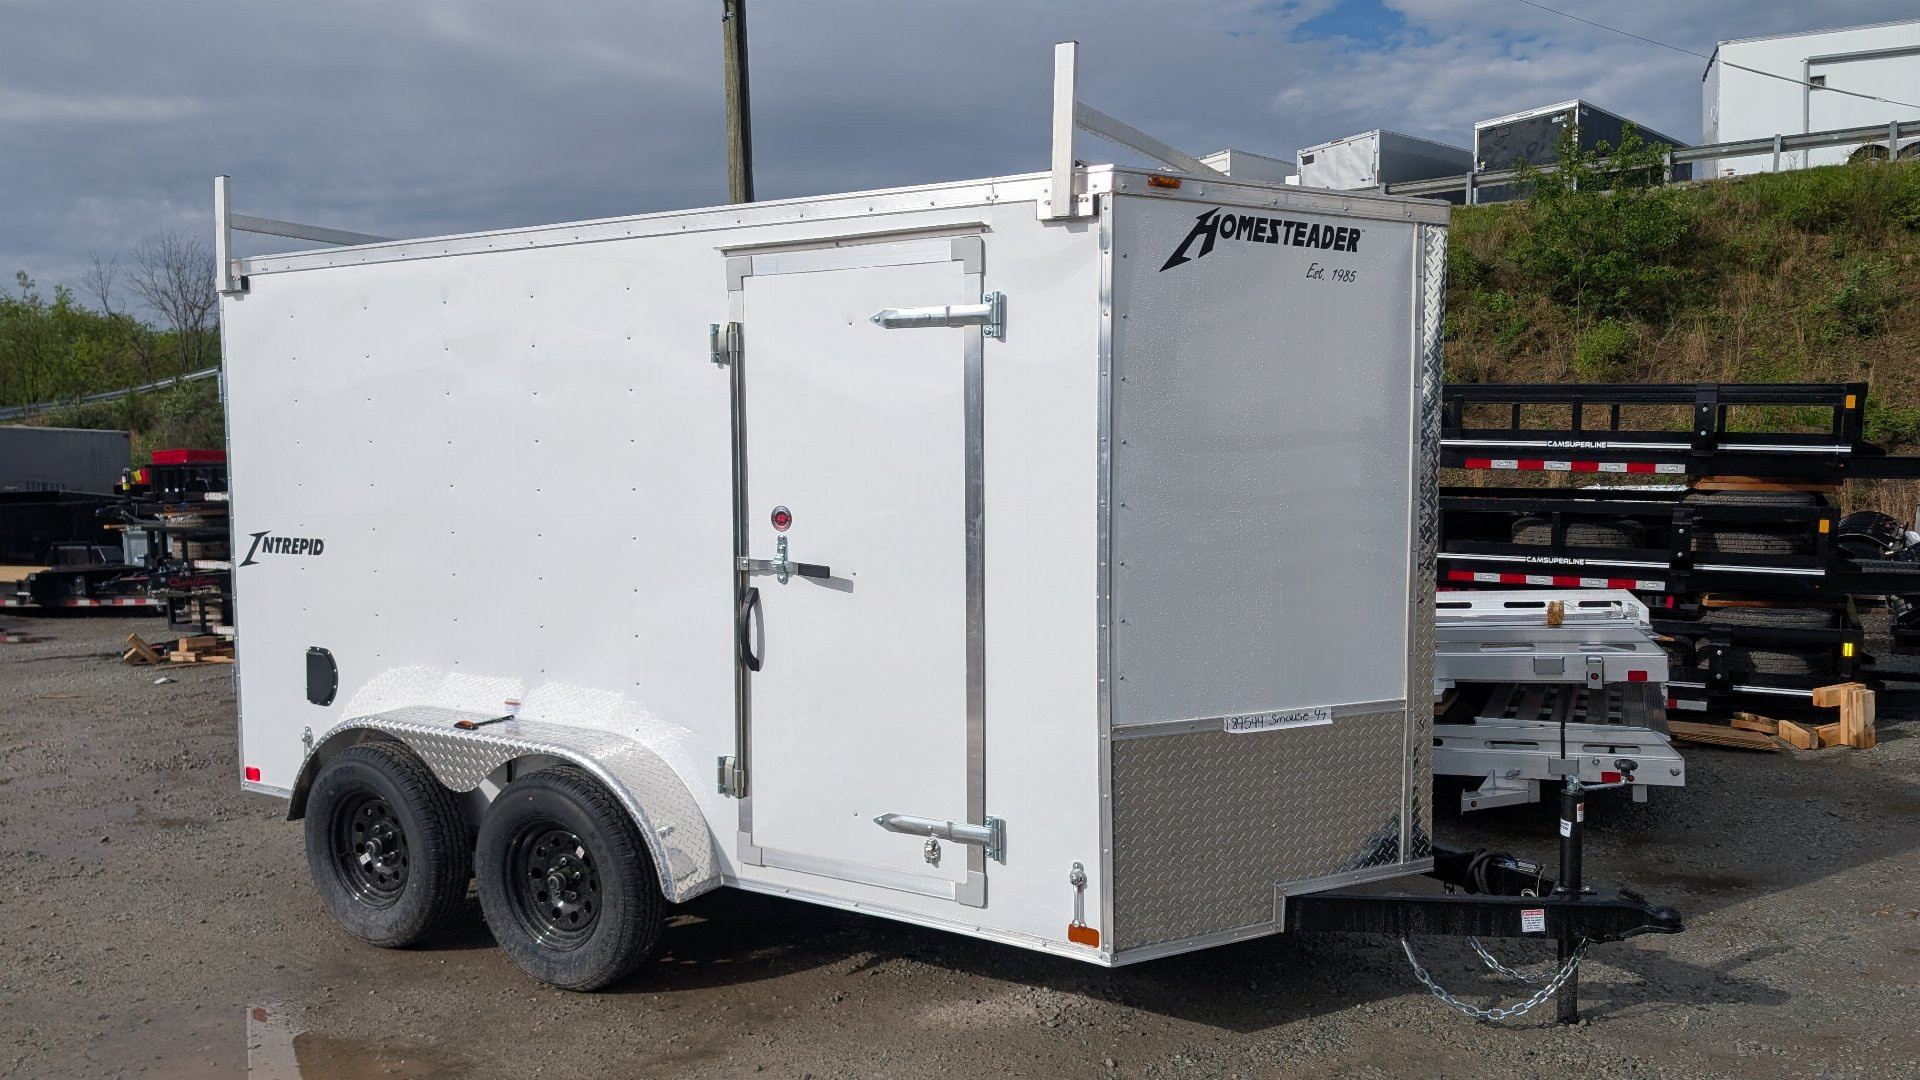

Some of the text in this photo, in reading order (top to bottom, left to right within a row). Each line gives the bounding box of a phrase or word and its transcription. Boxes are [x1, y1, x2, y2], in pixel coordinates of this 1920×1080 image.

[1159, 207, 1361, 272] HOMESTEADER
[1332, 269, 1357, 283] 1985
[1547, 441, 1607, 449] CAMSUPERLINE
[238, 530, 325, 567] INTREPID
[1526, 556, 1585, 565] CAMSUPERLINE
